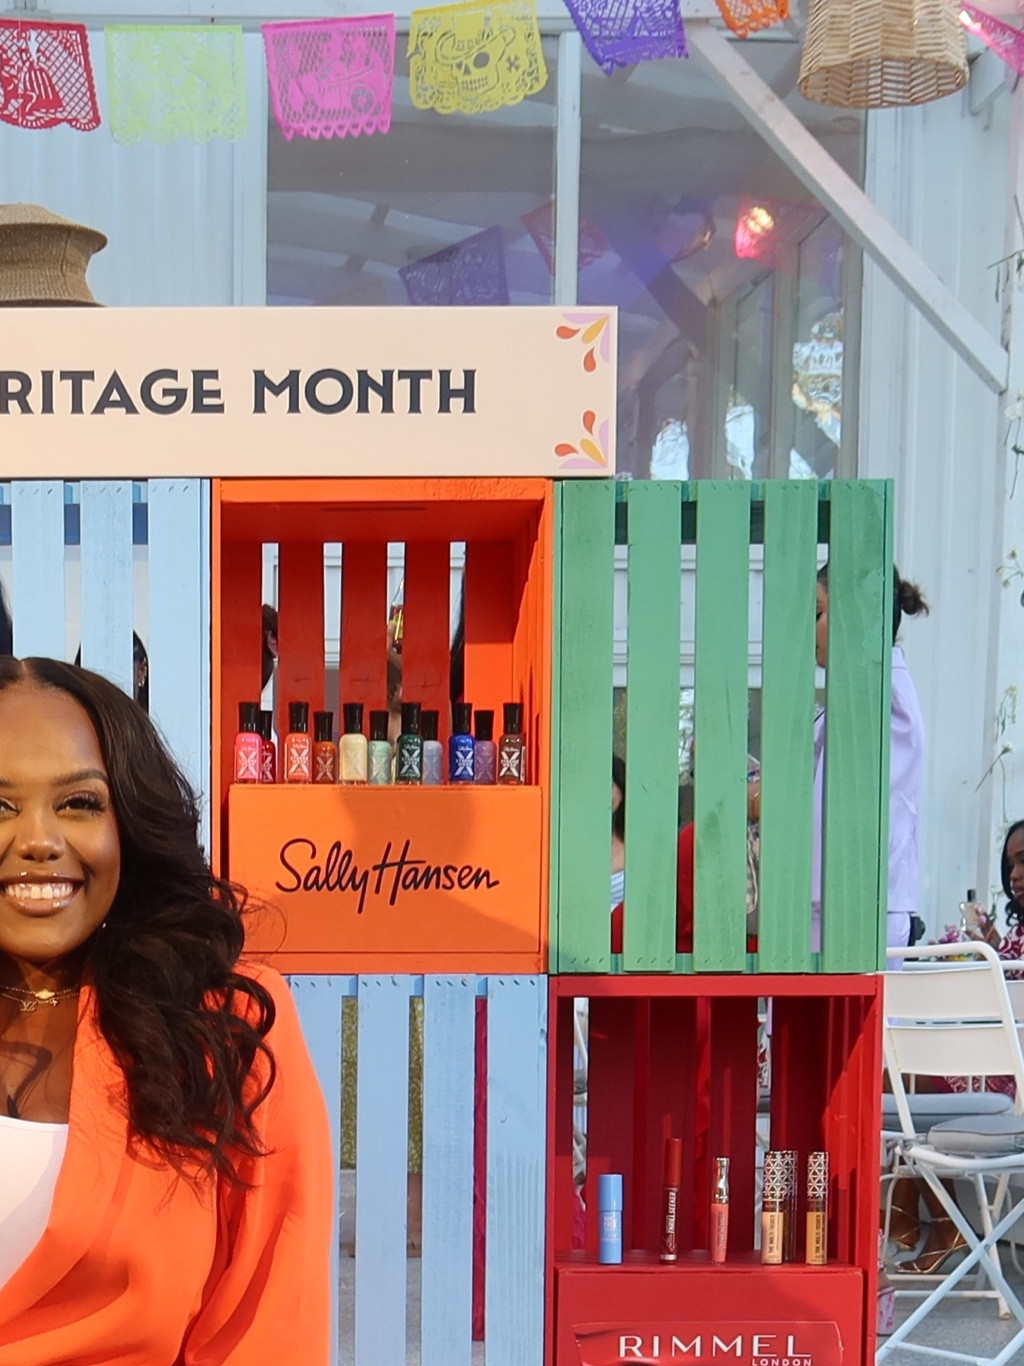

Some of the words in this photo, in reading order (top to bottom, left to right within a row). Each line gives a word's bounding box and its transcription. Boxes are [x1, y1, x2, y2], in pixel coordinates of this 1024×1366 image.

[252, 368, 477, 415] MONTH
[276, 838, 369, 914] Sally
[372, 839, 501, 906] Hansen
[619, 1335, 812, 1357] RIMMEL
[752, 1358, 812, 1366] LONDON
